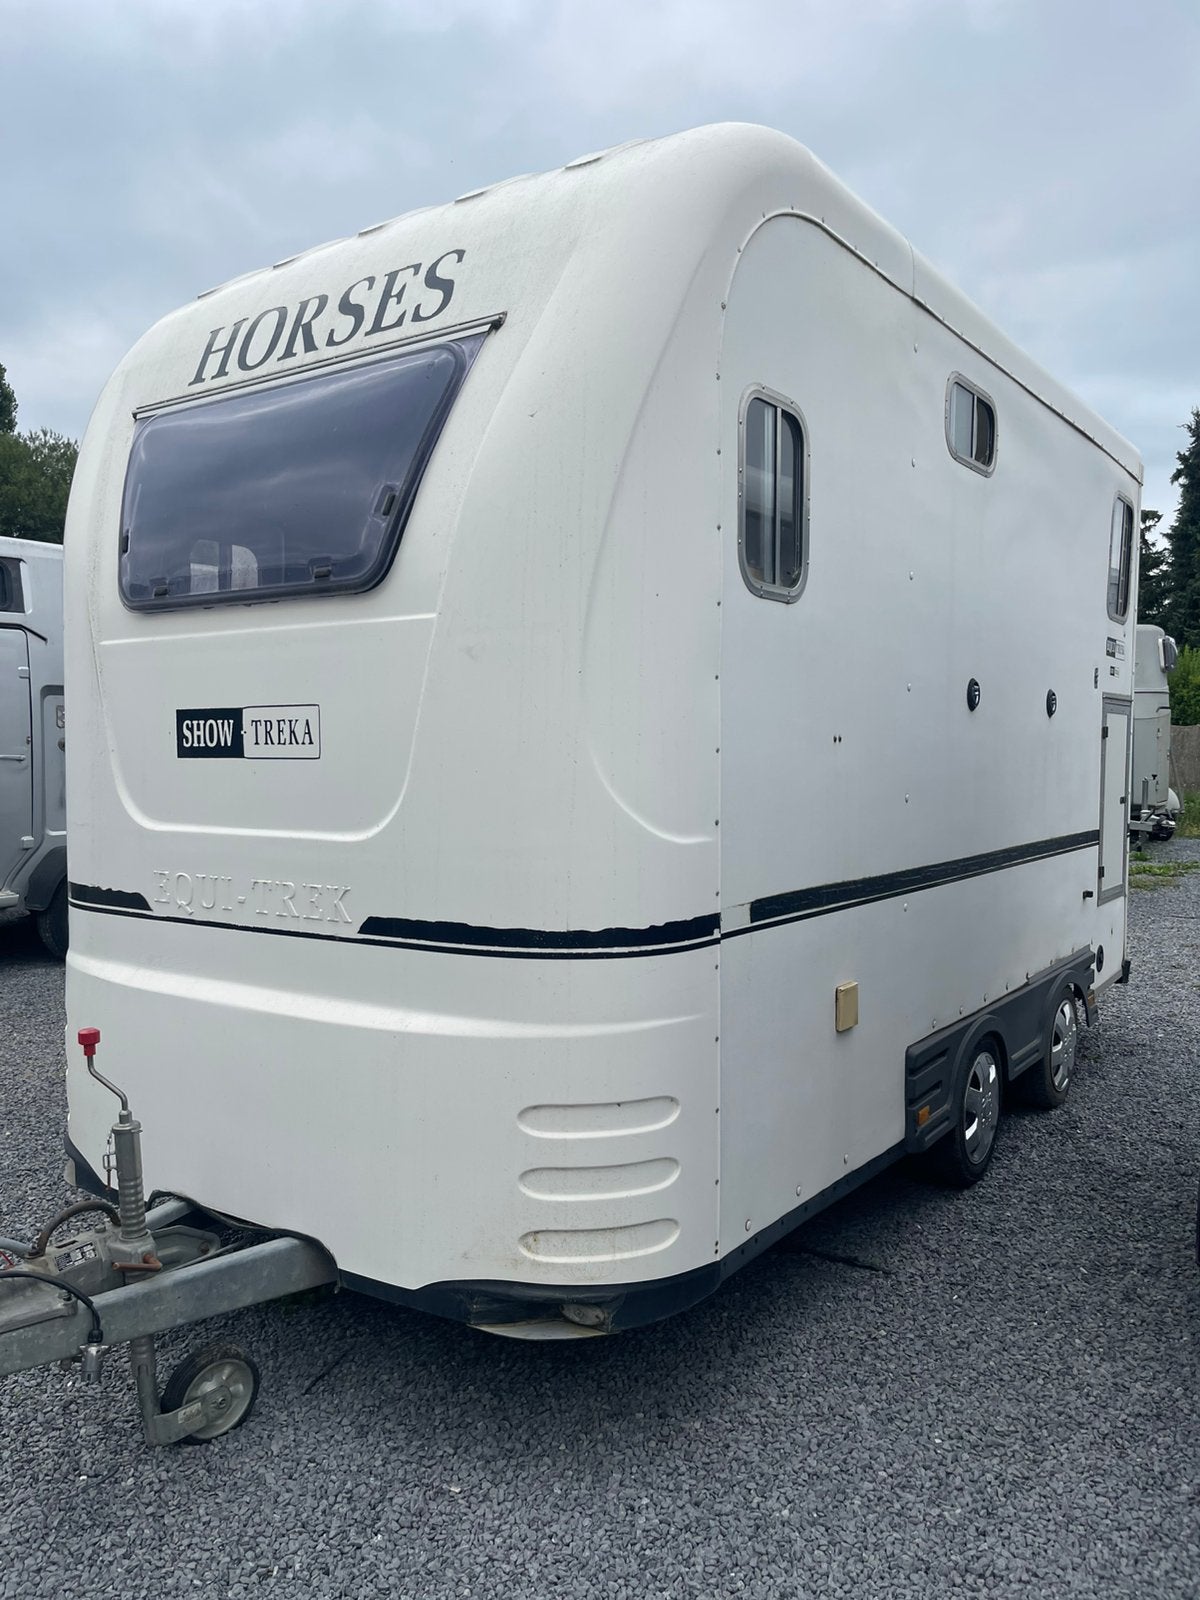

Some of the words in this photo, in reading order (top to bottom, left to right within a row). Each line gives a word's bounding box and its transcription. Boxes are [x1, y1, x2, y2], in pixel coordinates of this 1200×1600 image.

[188, 249, 466, 386] HORSES
[182, 719, 234, 747] SHOW
[251, 719, 314, 746] TREKA
[153, 870, 352, 923] EQUI-TREK
